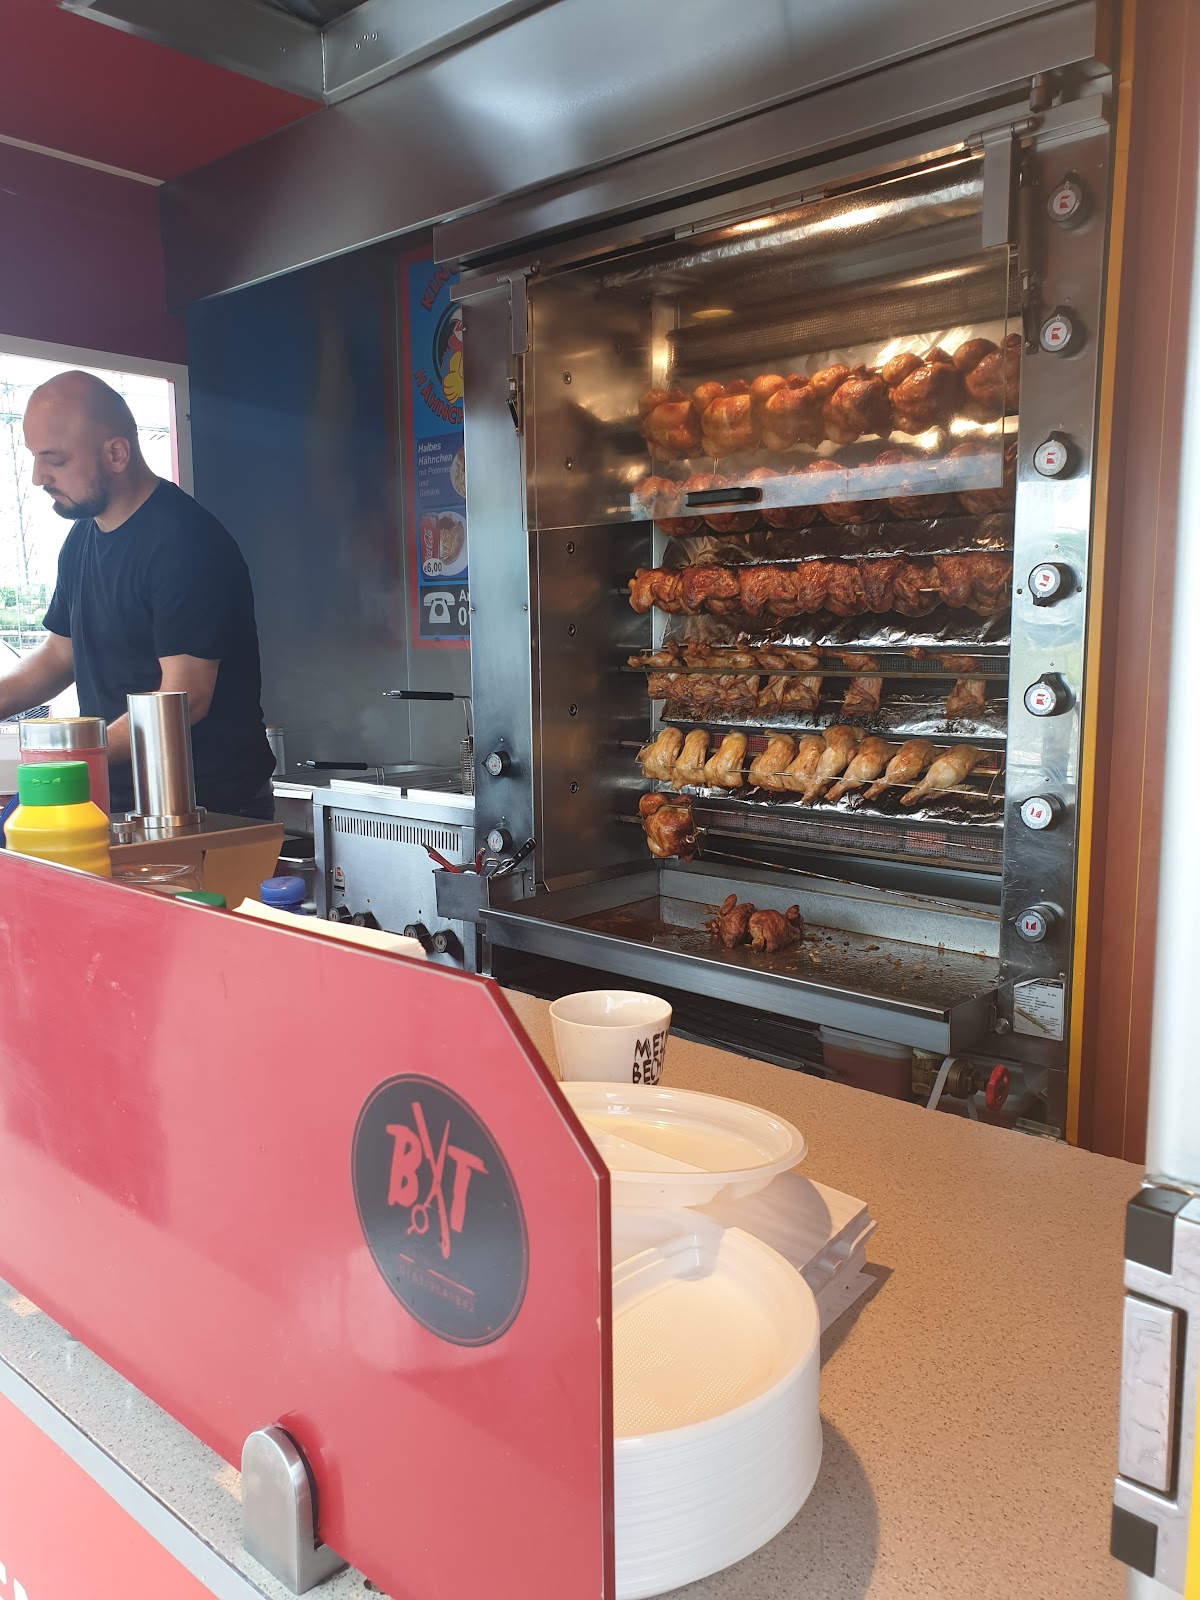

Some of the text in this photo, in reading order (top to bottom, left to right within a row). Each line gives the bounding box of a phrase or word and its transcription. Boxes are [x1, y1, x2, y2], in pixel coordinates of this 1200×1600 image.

[418, 442, 442, 453] Halbes
[418, 453, 453, 466] Hähnchen
[458, 606, 470, 626] 0
